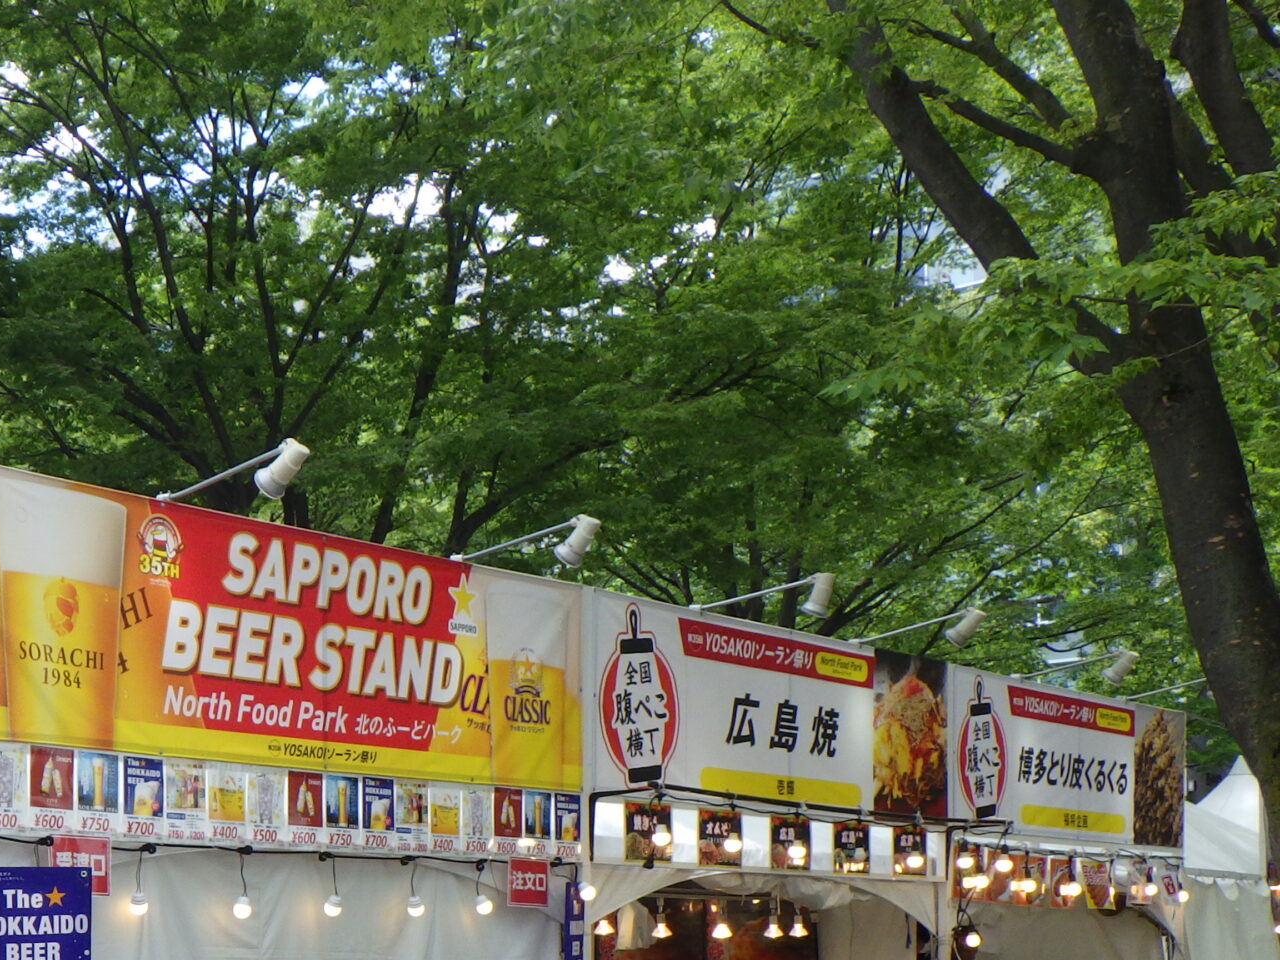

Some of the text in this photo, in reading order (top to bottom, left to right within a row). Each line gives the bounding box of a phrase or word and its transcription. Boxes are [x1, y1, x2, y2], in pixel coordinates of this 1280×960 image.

[139, 553, 180, 579] 35TH
[222, 531, 432, 626] SAPPORO
[19, 640, 105, 671] SORACHI
[161, 597, 463, 706] BEER STAND
[705, 632, 814, 669] YOSAKOIソーラン祭り
[42, 667, 82, 689] 1984
[624, 661, 651, 686] 全国
[163, 685, 463, 745] North Food Park 北のふーどパーク
[504, 695, 551, 725] CLASSIC
[615, 690, 667, 725] 腹ぺこ
[725, 693, 839, 758] 広島焼
[973, 721, 990, 741] 全国
[283, 743, 377, 763] YOSAKOIソーラン祭り
[626, 728, 659, 758] 横丁
[967, 744, 1000, 772] 腹ぺこ
[1018, 746, 1127, 795] 博多とり皮くるくる
[974, 774, 995, 798] 横丁
[34, 814, 64, 829] ¥600
[81, 816, 110, 832] ¥750
[127, 821, 155, 836] ¥700
[212, 825, 238, 839] ¥400
[253, 828, 277, 842] ¥500
[292, 830, 316, 845] ¥600
[329, 832, 352, 846] ¥750
[365, 835, 388, 848] ¥700
[432, 838, 453, 851] ¥400
[466, 840, 487, 853] ¥500
[496, 841, 516, 853] ¥600
[556, 844, 576, 857] ¥700
[511, 870, 547, 891] 注文口
[3, 889, 44, 909] The
